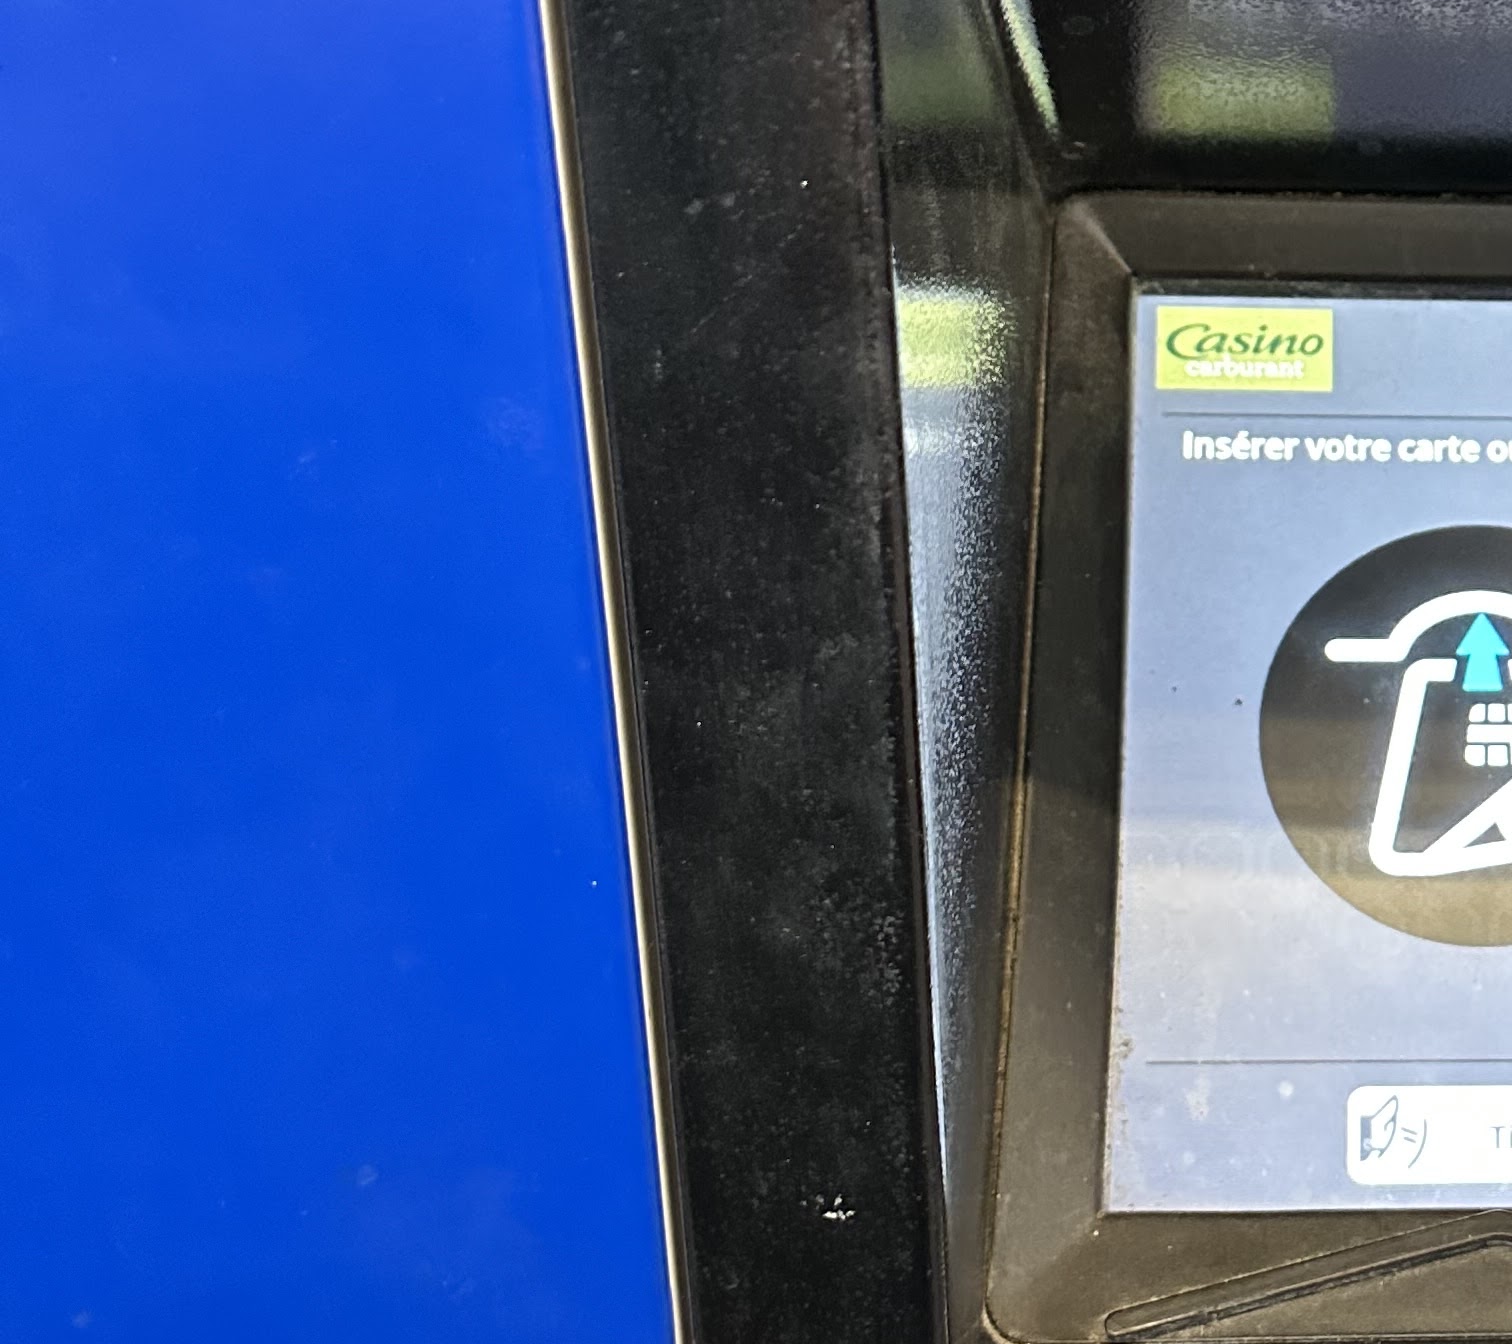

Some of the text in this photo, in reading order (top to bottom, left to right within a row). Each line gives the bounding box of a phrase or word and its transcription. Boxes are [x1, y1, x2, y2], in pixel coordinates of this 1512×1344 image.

[1166, 322, 1324, 361] Casino
[1184, 354, 1305, 379] carburant
[1182, 430, 1299, 461] Insérer
[1304, 434, 1391, 462] votre
[1397, 435, 1481, 463] carte
